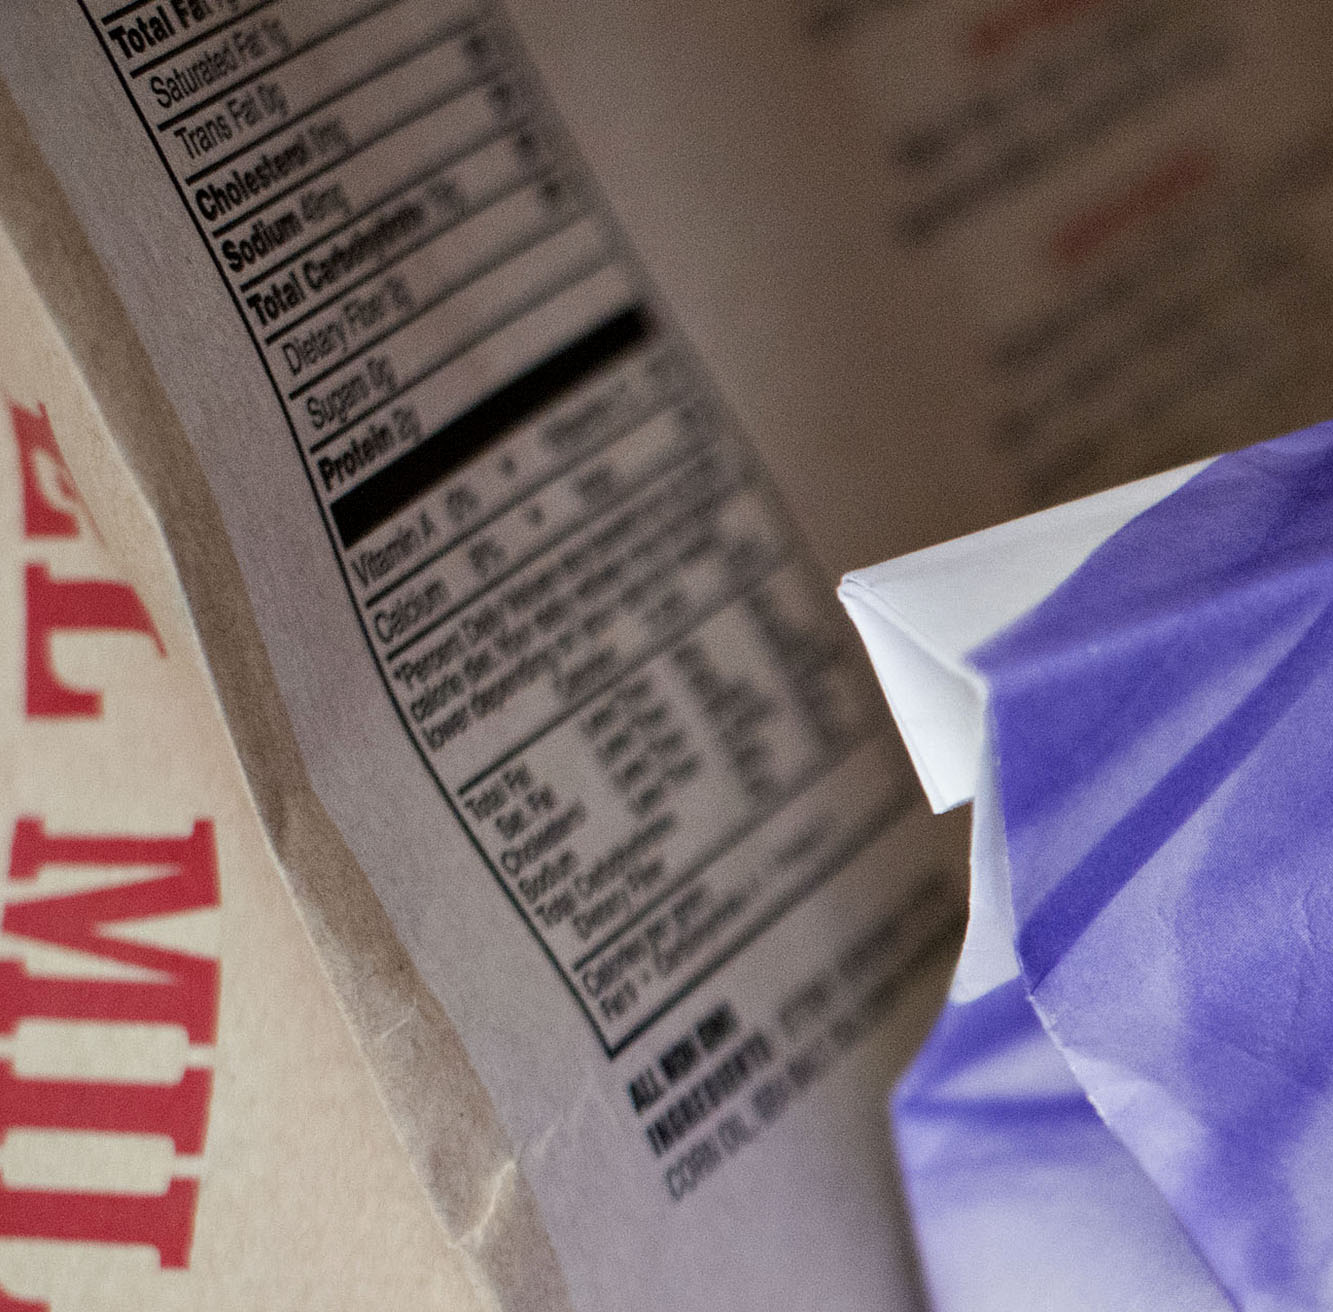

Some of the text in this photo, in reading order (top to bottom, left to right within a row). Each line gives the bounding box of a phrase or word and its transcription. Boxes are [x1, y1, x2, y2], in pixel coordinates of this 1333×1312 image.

[108, 5, 175, 59] Total
[149, 41, 239, 109] Saturated
[173, 114, 233, 159] Trans
[221, 211, 302, 272] Sodium
[245, 272, 305, 326] Total
[317, 425, 394, 491] Protein
